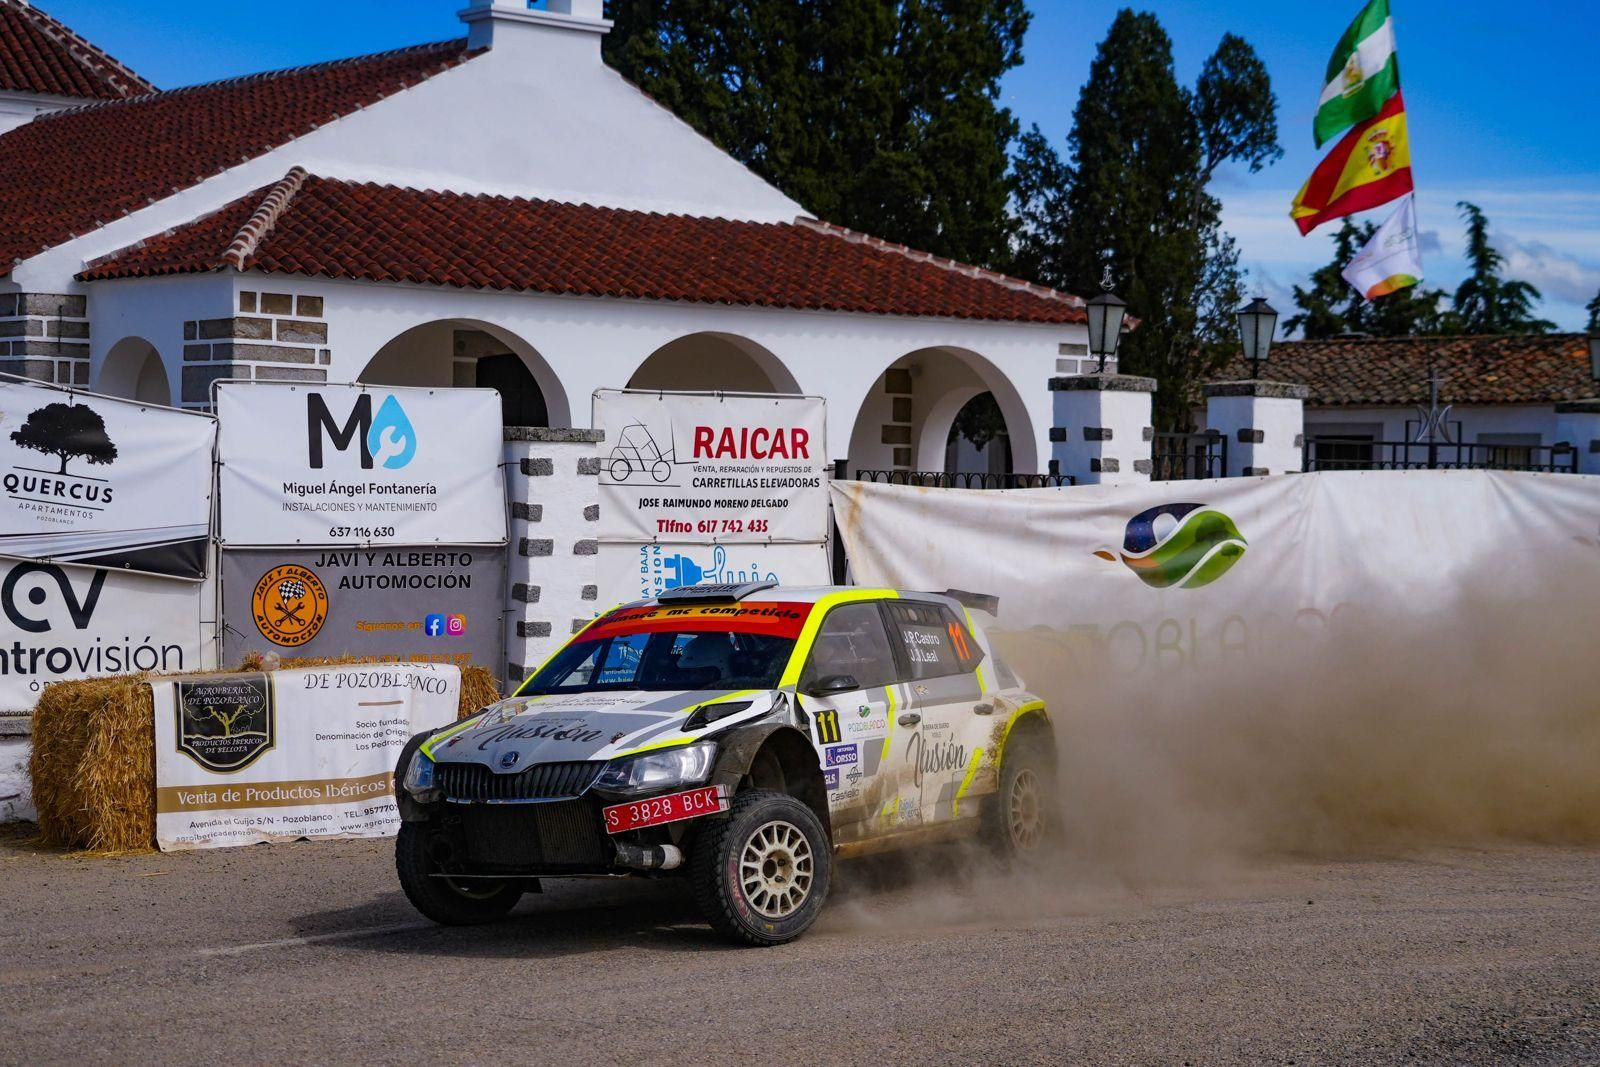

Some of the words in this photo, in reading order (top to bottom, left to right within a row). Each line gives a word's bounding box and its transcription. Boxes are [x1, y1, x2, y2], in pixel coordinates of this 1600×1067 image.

[692, 426, 810, 460] RAICAR
[693, 466, 718, 474] VENTA,
[719, 464, 759, 473] REPARACIÓN
[3, 473, 113, 504] QUERCUS
[283, 483, 326, 497] Miguel
[329, 479, 366, 497] Ángel
[369, 482, 437, 495] Fontanería
[692, 477, 758, 488] CARRETILLAS
[760, 477, 820, 488] ELEVADORAS
[18, 502, 94, 520] APARTAMENTOS
[282, 502, 356, 512] INSTALACIONES
[357, 503, 364, 512] Y
[365, 502, 437, 512] MANTENIMIENTO
[638, 498, 659, 509] JOSE
[663, 498, 712, 509] RAIMUNDO
[714, 498, 749, 509] MORENO
[750, 498, 789, 508] DELGADO
[329, 527, 351, 537] 637
[353, 527, 371, 537] 116
[373, 527, 395, 537] 630
[656, 519, 693, 533] Tlfno
[697, 519, 716, 533] 617
[721, 519, 743, 533] 742
[747, 519, 768, 533] 435
[315, 553, 358, 567] JAVI
[365, 553, 376, 567] Y
[382, 553, 472, 567] ALBERTO
[640, 544, 649, 574] BAJA
[276, 568, 283, 577] Y
[286, 567, 325, 600] ALBERTO
[338, 570, 472, 590] AUTOMOCIÓN
[948, 622, 972, 661] 11
[304, 672, 330, 690] DE
[335, 672, 448, 695] POZOBLANCO
[203, 695, 260, 705] POZOBLANCO
[356, 720, 377, 728] Socio
[817, 710, 839, 743] 11
[315, 732, 371, 741] Denominación
[373, 730, 384, 738] de
[356, 743, 370, 751] Los
[835, 753, 857, 763] ORSSO
[178, 791, 217, 805] Venta
[221, 788, 241, 802] de
[246, 785, 321, 802] Productos
[325, 780, 386, 798] Ibéricos
[609, 810, 619, 826] S
[629, 799, 672, 822] 3828
[682, 790, 715, 812] BCK
[189, 819, 222, 829] Avenida
[224, 818, 231, 826] el
[257, 817, 274, 826] S/N
[282, 814, 333, 824] Pozoblanco
